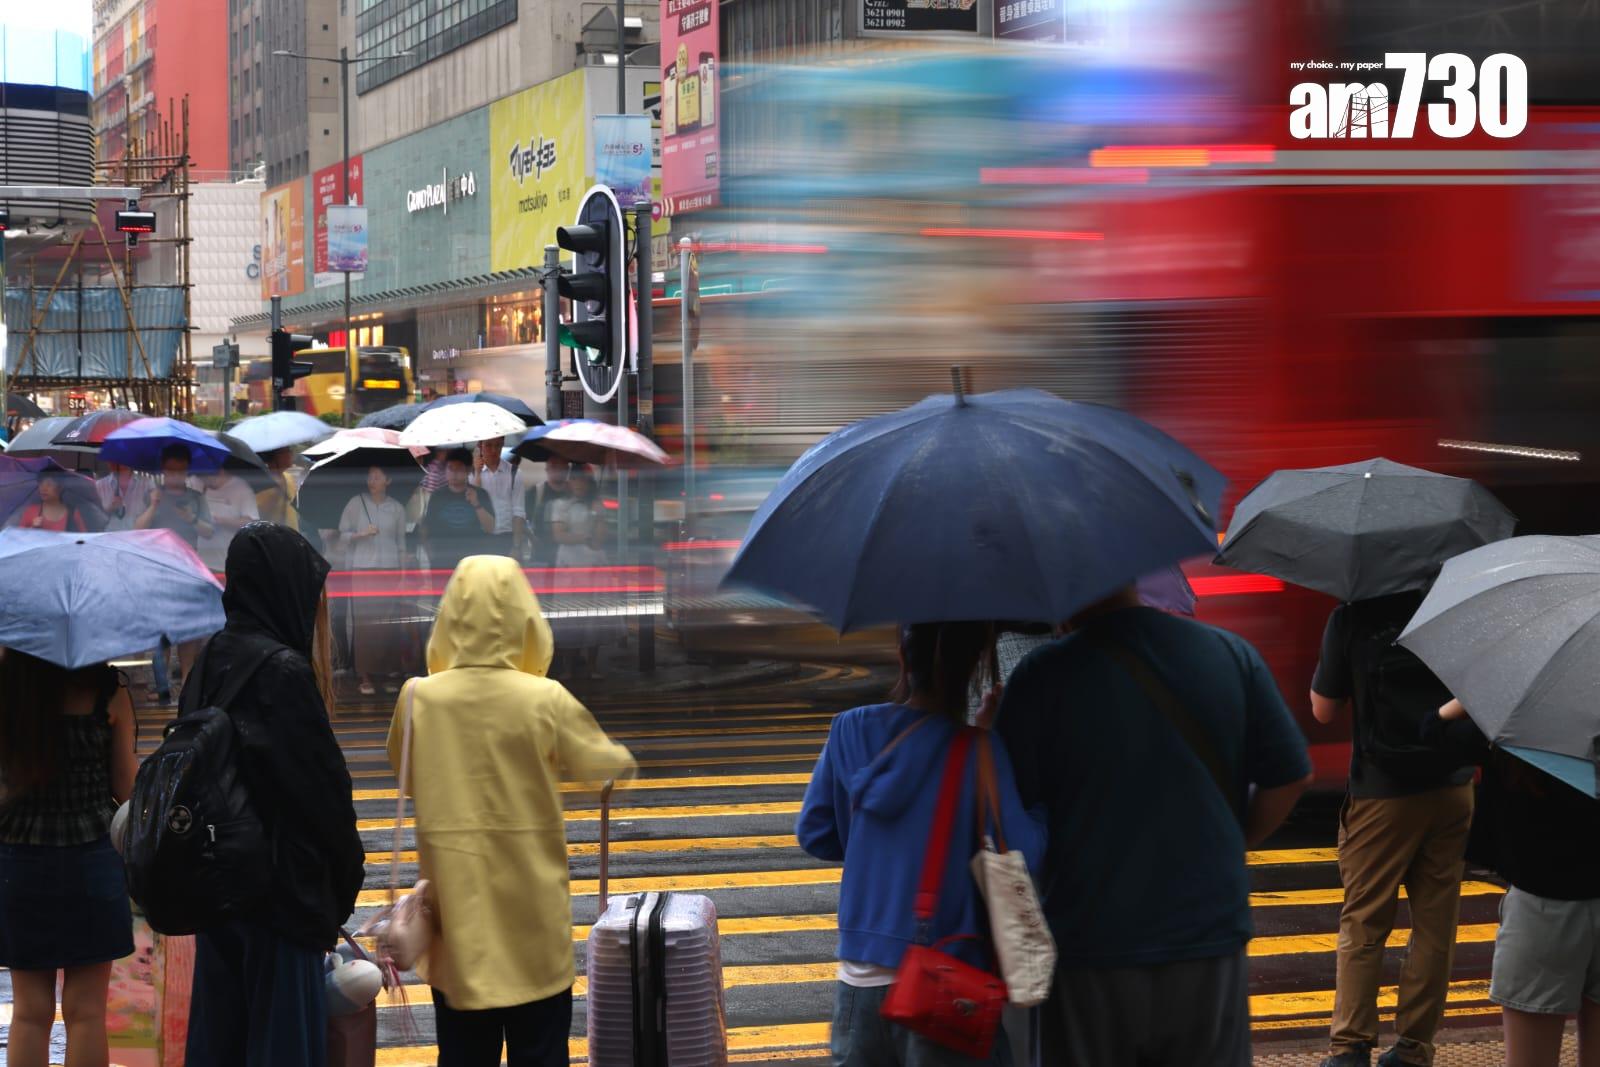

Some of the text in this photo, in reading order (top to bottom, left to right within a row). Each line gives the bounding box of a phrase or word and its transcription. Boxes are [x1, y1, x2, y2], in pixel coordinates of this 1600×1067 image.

[865, 9, 905, 17] 3621 0901
[865, 18, 906, 27] 3621 0902
[518, 189, 548, 214] matsukiyo
[68, 398, 85, 409] S14
